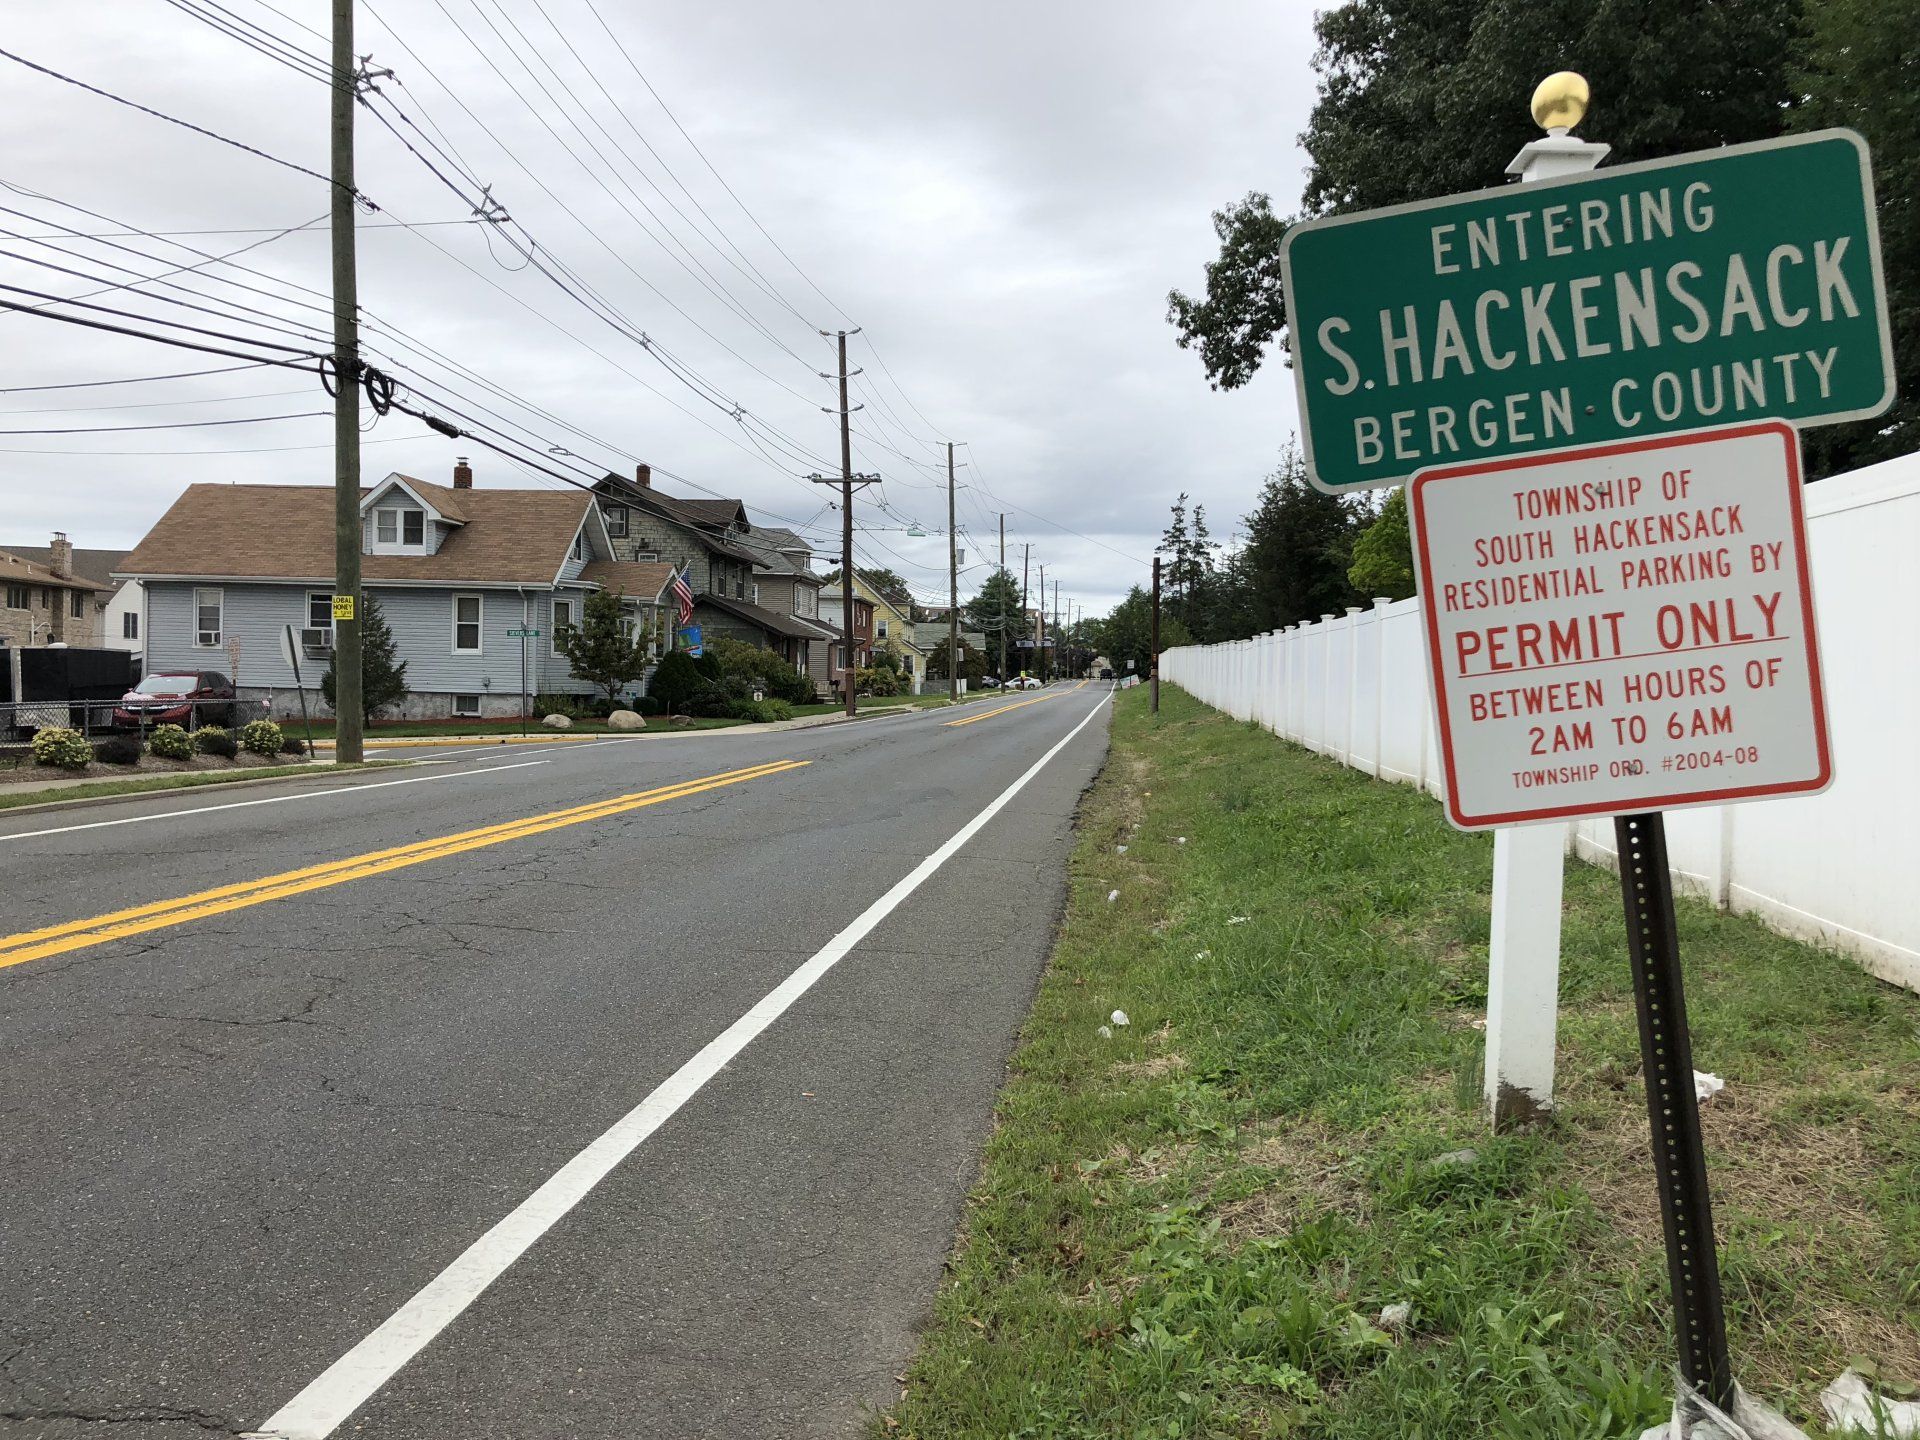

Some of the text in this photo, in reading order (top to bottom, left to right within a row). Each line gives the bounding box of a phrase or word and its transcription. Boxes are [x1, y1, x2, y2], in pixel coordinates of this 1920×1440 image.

[1431, 181, 1715, 276] ENTERING
[1353, 346, 1839, 466] BERGEN COUNTY
[1513, 469, 1692, 521] TOWNSHIP OF
[1474, 504, 1745, 568] SOUTH HACKENSACK
[1443, 541, 1784, 612] RESIDENTIAL PARKING BY
[1455, 592, 1783, 676] PERMIT ONLY
[1470, 657, 1784, 722] BETWEEN HOURS OF
[1529, 705, 1734, 756] 2AM TO 6AM
[1512, 746, 1760, 789] TOWNSHIP ORD. #2004-08
